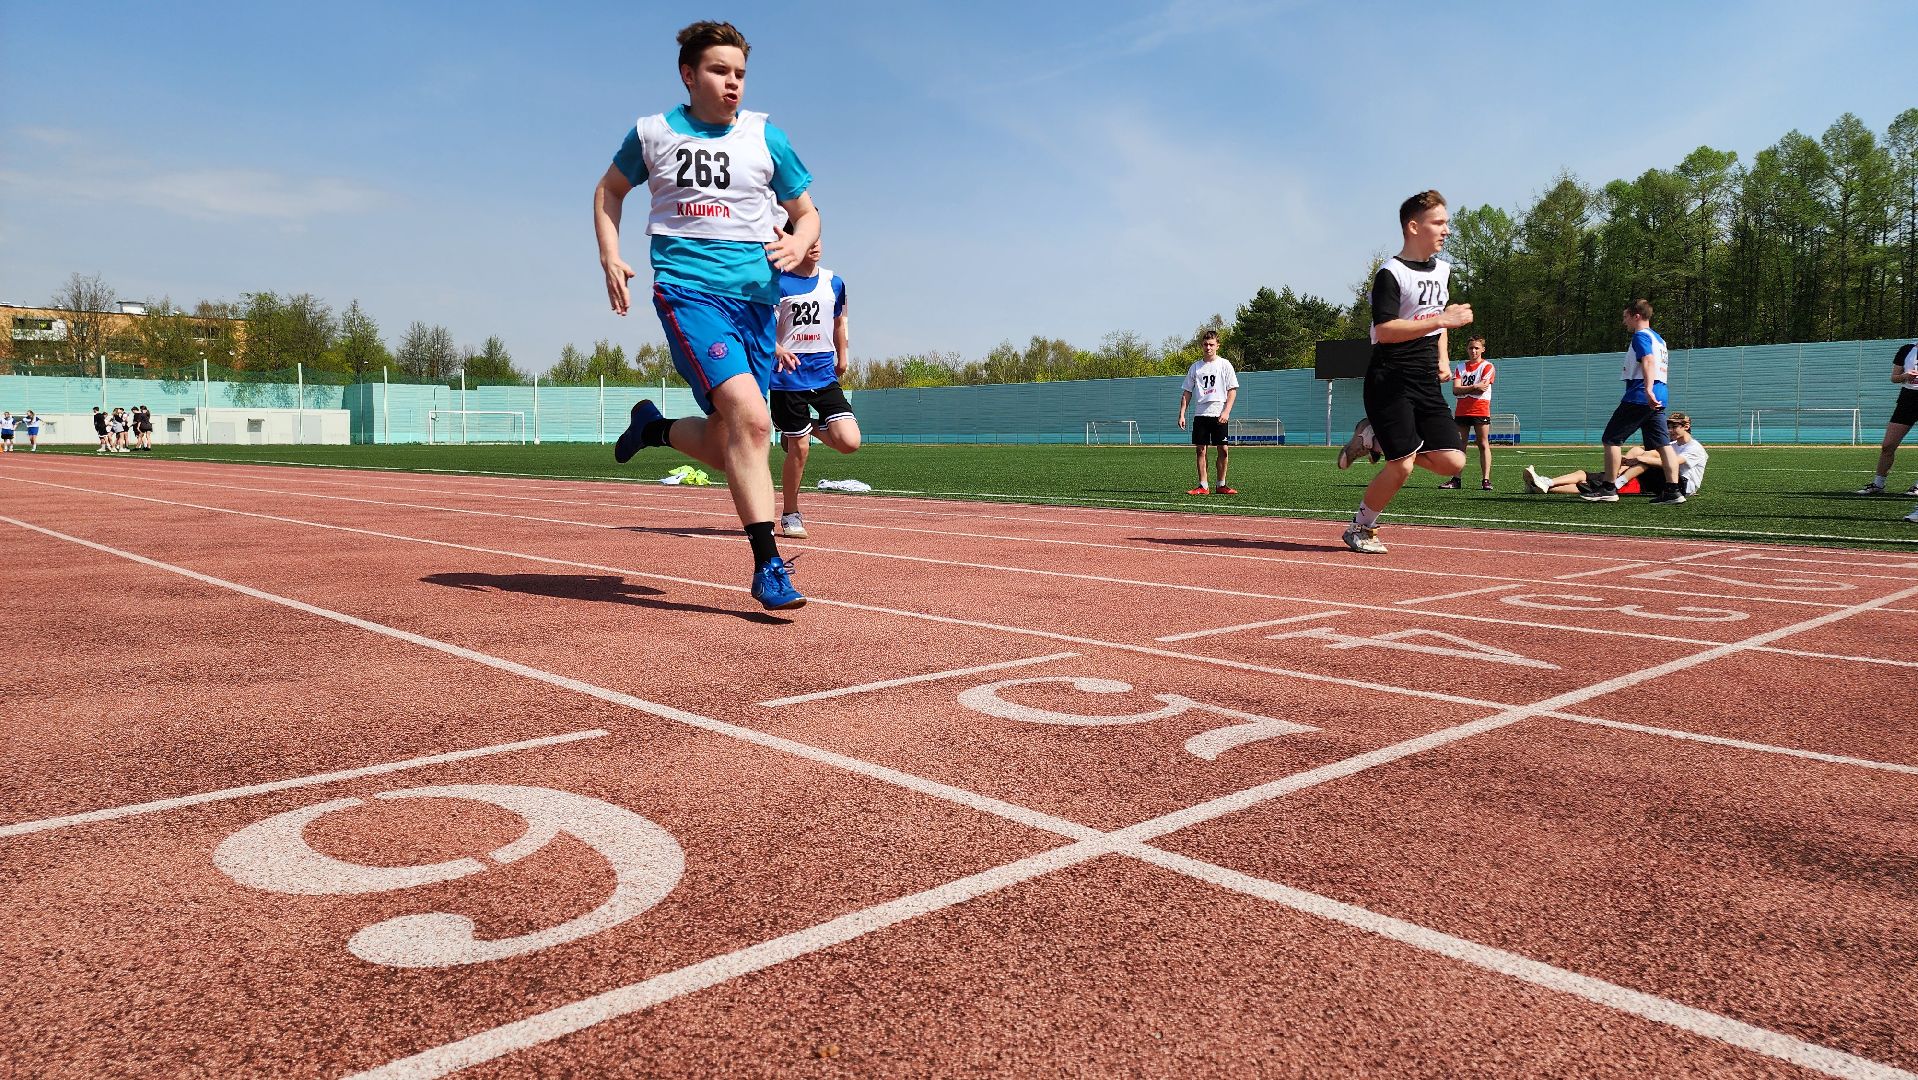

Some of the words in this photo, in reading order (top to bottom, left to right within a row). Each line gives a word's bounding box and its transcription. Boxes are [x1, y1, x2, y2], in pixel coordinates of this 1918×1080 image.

[676, 149, 730, 190] 263
[677, 202, 730, 218] КАШИРА
[1418, 280, 1443, 305] 272
[791, 301, 820, 326] 232
[1203, 375, 1216, 388] 78
[1626, 569, 1860, 591] 2
[1499, 593, 1752, 622] 3
[1265, 627, 1563, 670] 4
[957, 675, 1324, 761] 5
[212, 784, 686, 968] 6
